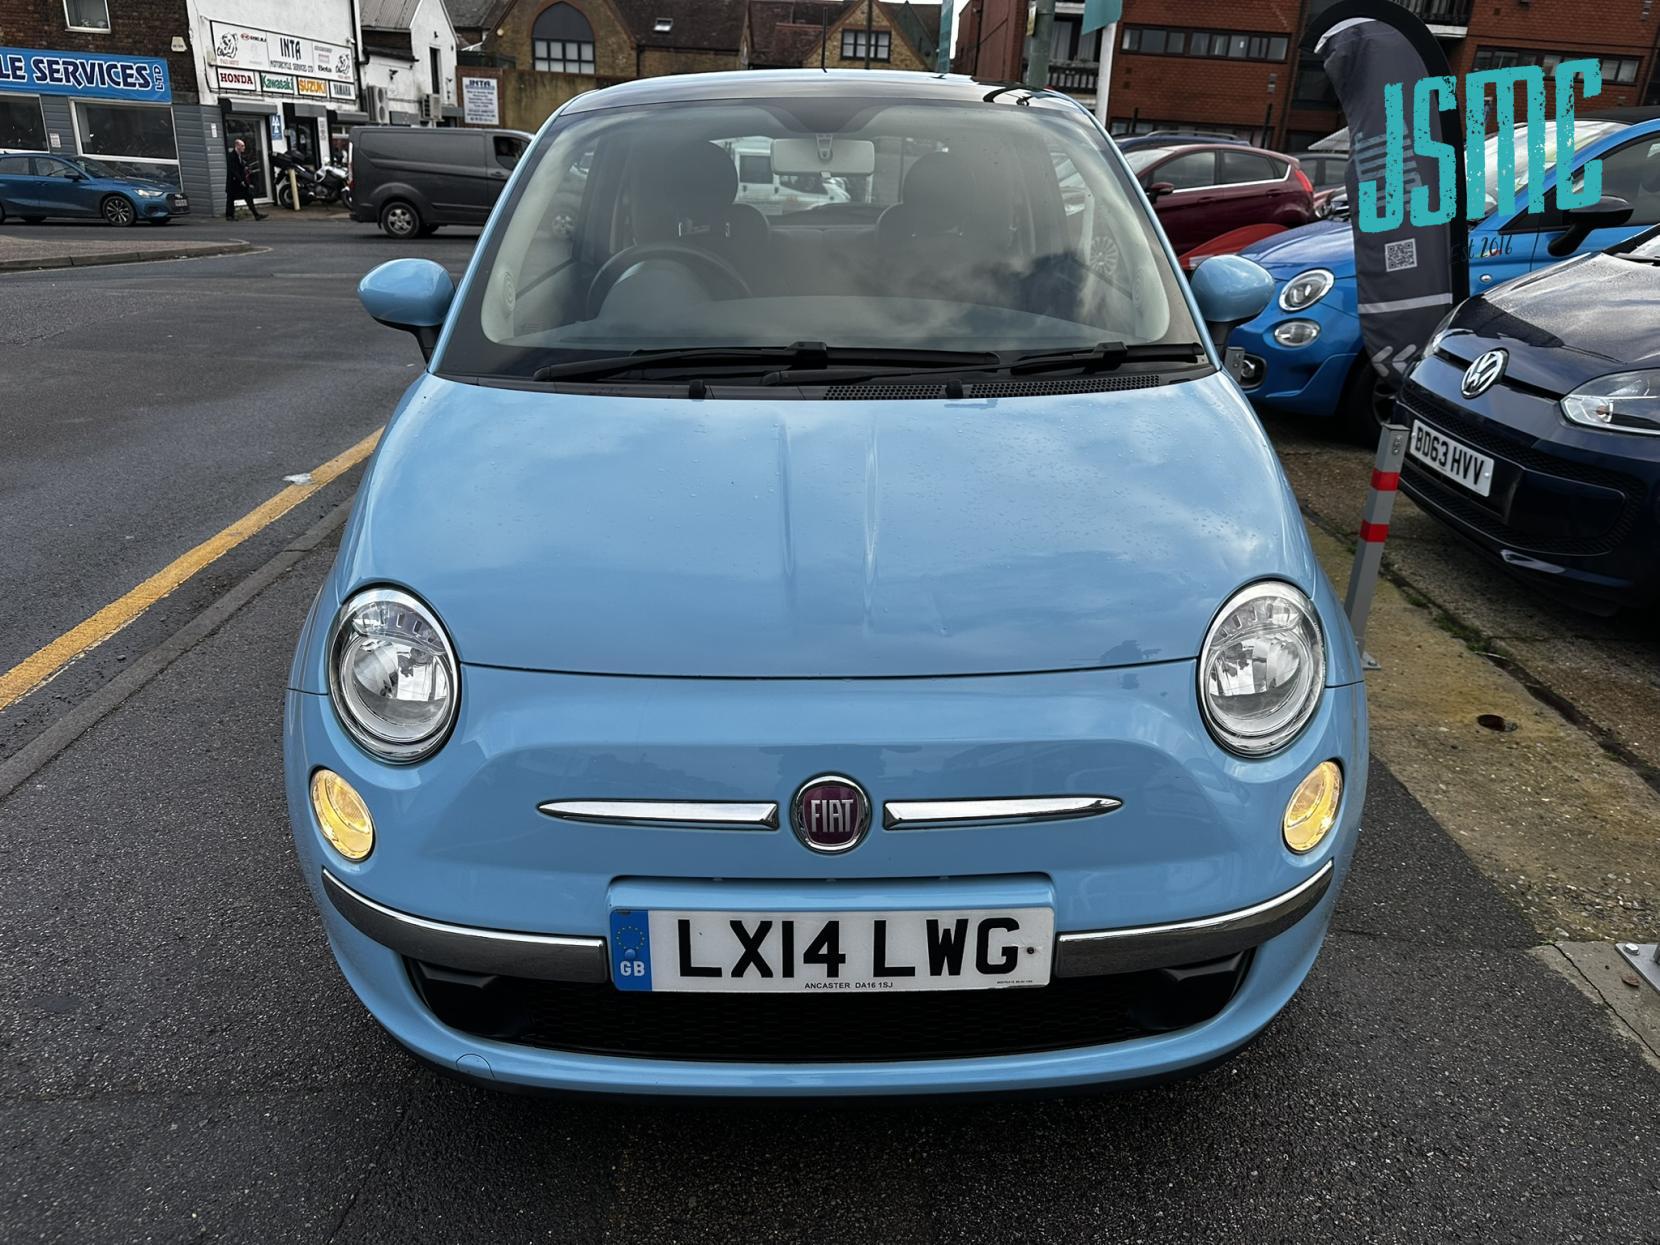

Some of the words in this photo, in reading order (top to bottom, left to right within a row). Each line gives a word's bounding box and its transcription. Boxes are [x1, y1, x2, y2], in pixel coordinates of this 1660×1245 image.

[280, 37, 302, 60] INTA
[31, 56, 152, 91] SERVICES
[153, 64, 165, 91] LTD
[220, 73, 254, 85] HONDA
[261, 74, 294, 91] Kawasaki
[300, 79, 326, 94] SUZUKI
[1415, 426, 1449, 468] BD63
[1450, 446, 1484, 486] HVV
[811, 799, 854, 833] FIAT
[677, 918, 847, 979] LX14
[872, 917, 1020, 978] LWG
[620, 960, 645, 977] GB
[855, 981, 876, 989] DA16
[878, 981, 893, 989] 1SJ
